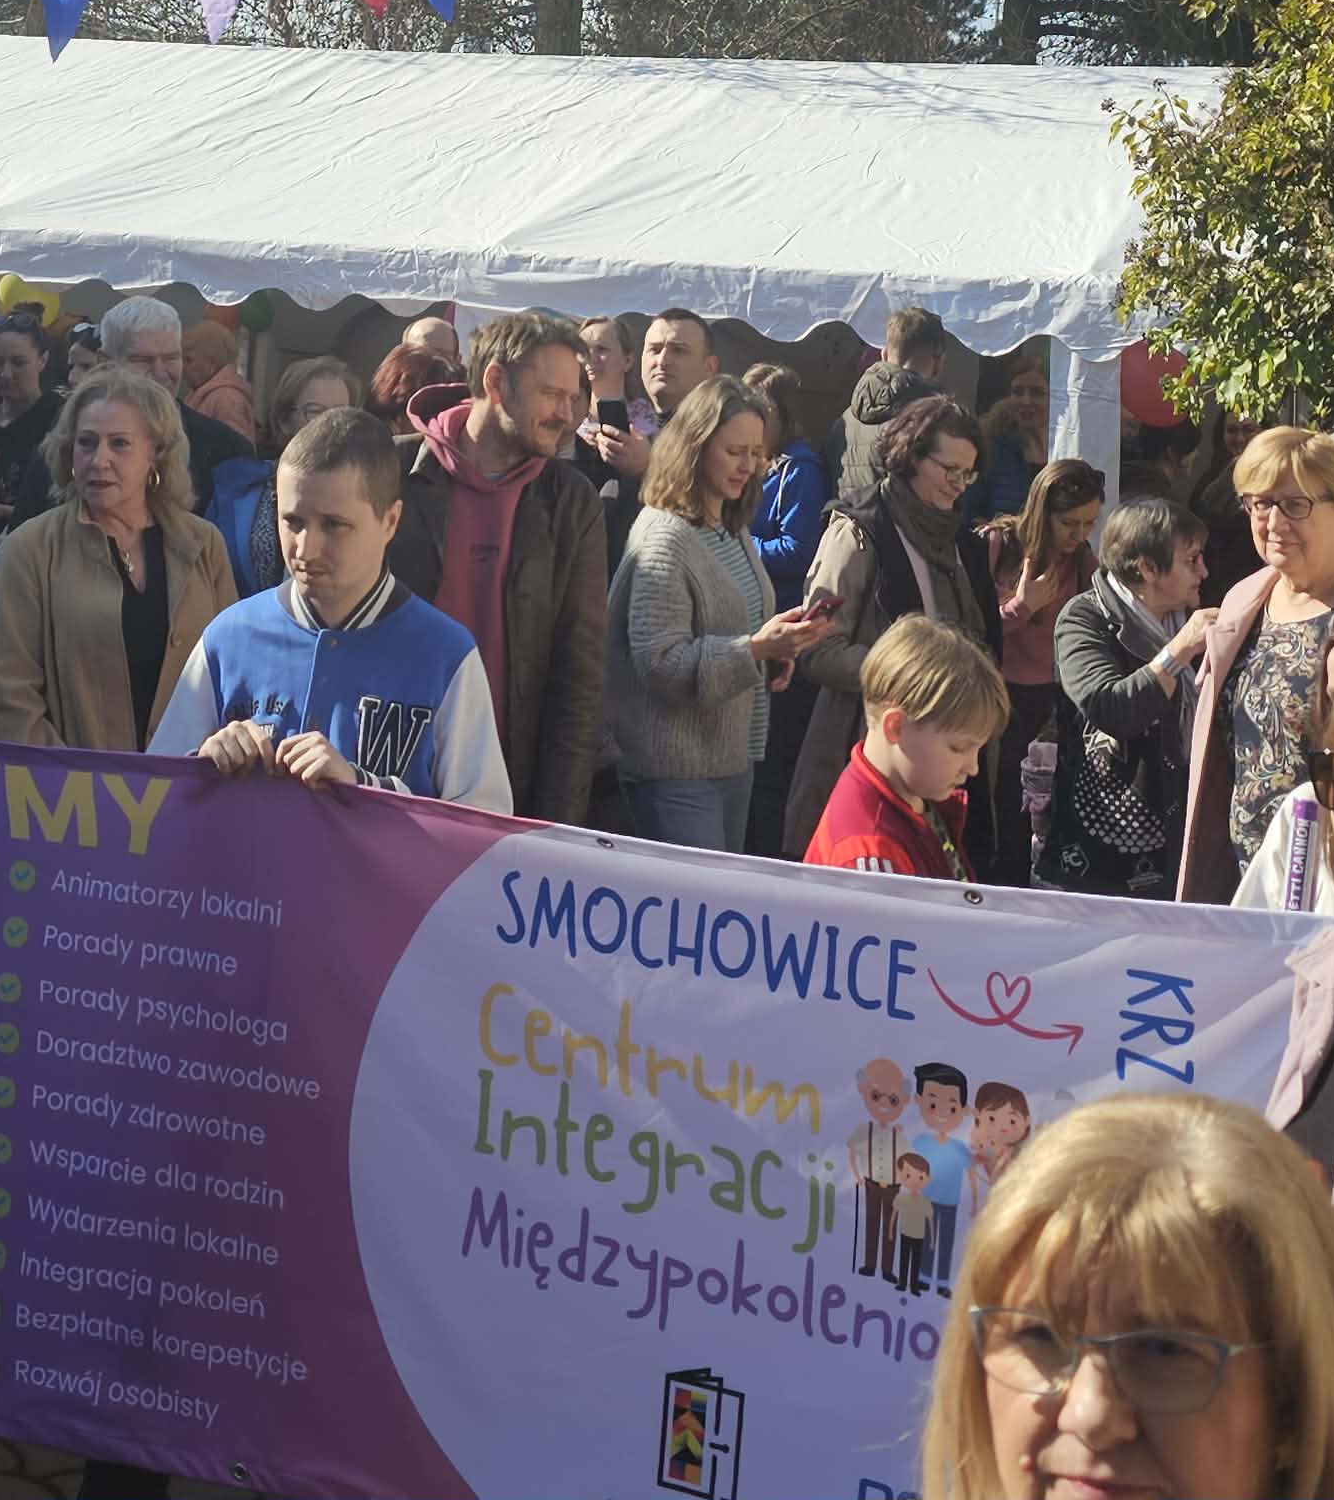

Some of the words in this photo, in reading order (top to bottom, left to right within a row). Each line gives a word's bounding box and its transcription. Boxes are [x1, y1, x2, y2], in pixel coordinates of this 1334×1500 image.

[358, 696, 432, 776] W
[51, 868, 194, 918] Animatorzy
[202, 888, 282, 927] lokalni
[43, 924, 133, 964] Porady
[141, 938, 238, 977] prawne
[497, 870, 917, 1019] SMOCHOWICE
[39, 979, 129, 1018] Porady
[137, 994, 288, 1047] psychologa
[36, 1029, 172, 1075] Doradztwo
[177, 1056, 320, 1100] zawodowe
[479, 983, 821, 1133] Centrum
[33, 1085, 123, 1126] Porady
[129, 1103, 266, 1147] zdrowotne
[30, 1139, 147, 1185] Wsparcie
[155, 1162, 198, 1192] dla
[204, 1174, 284, 1210] rodzin
[474, 1070, 835, 1254] Integracji
[27, 1194, 176, 1246] Wydarzenia
[184, 1224, 279, 1267] lokalne
[20, 1251, 152, 1298] Integracja
[160, 1278, 266, 1319] pokoleń
[15, 1304, 145, 1349] Bezpłatne
[152, 1328, 308, 1383] korepetycje
[14, 1361, 104, 1407] Rozwój
[108, 1378, 219, 1428] osobisty
